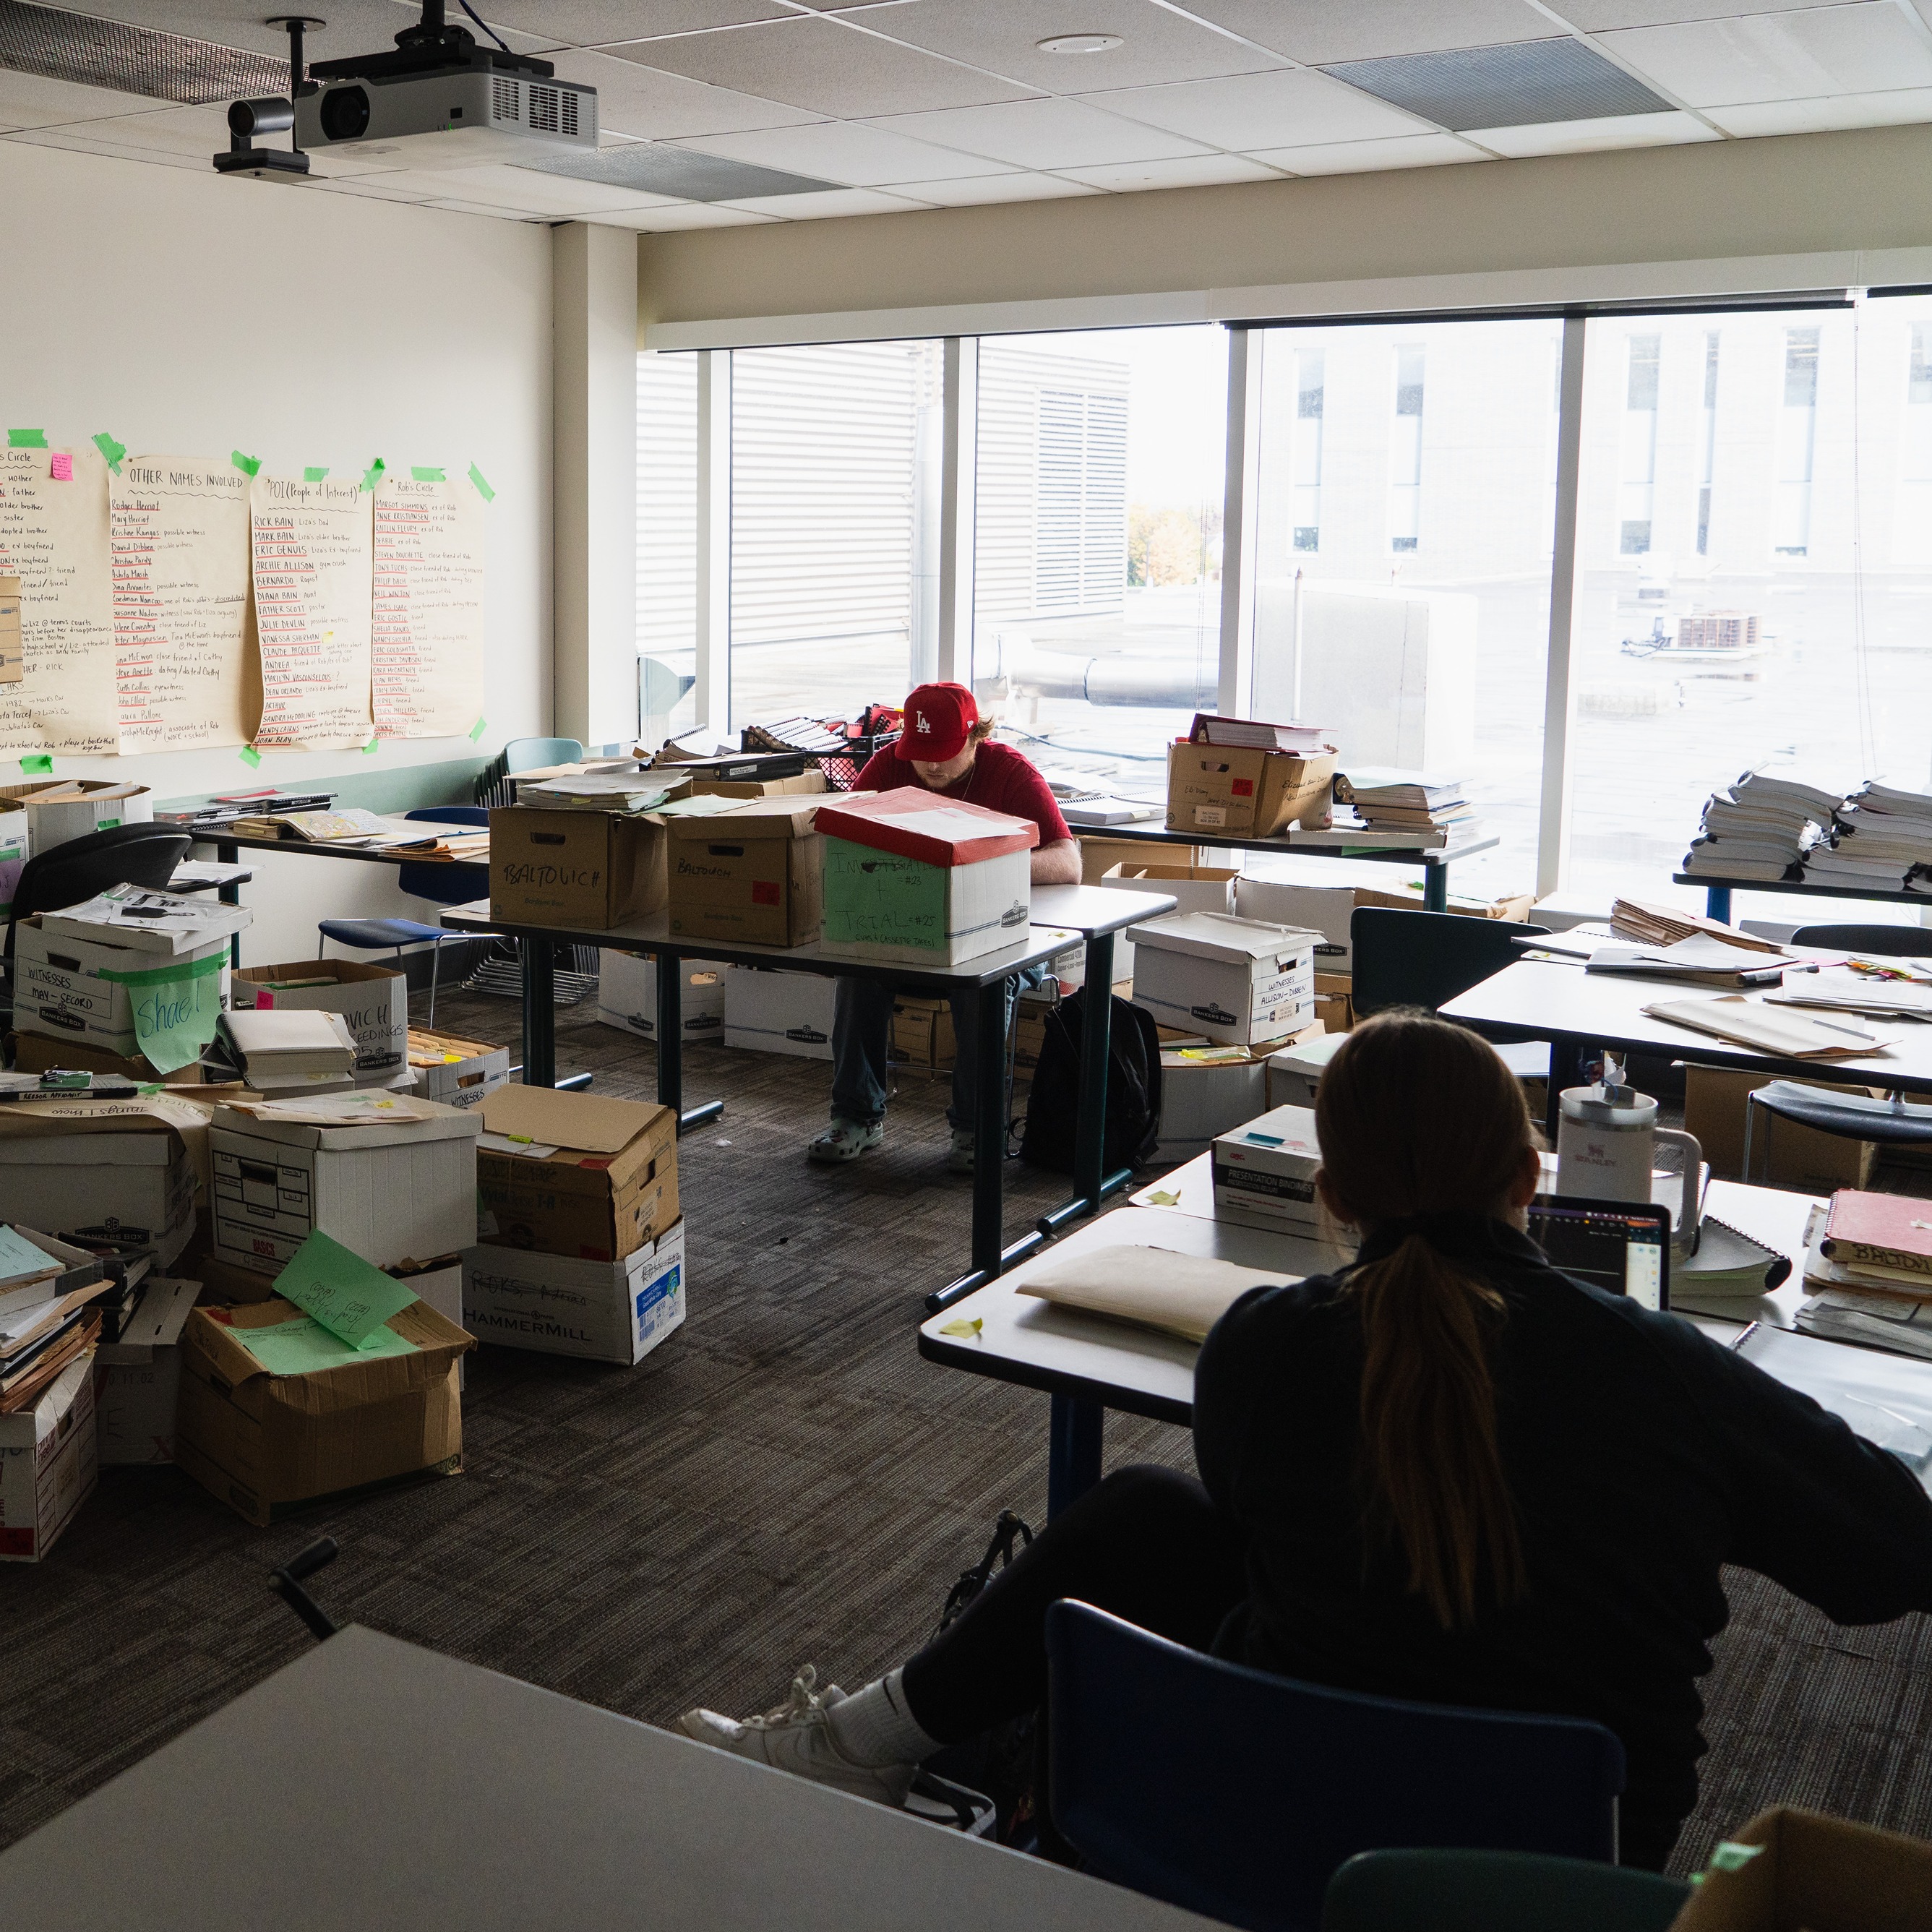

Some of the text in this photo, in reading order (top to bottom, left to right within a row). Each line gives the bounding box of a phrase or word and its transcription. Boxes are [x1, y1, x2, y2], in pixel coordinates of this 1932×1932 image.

[7, 452, 32, 462] Circle
[129, 468, 244, 489] OTHER NAMES INVOLVED
[12, 486, 36, 496] father
[398, 481, 434, 493] Rob's Circle
[376, 499, 428, 510] MARGOT SIMMONS
[254, 515, 275, 528] RICK
[376, 512, 391, 520] ANNE
[255, 532, 275, 541] MARK
[255, 545, 273, 556] ERIC
[255, 561, 281, 571] ARCHIE
[257, 592, 279, 601] DIANA
[258, 605, 305, 615] FATHER SCOTT
[262, 634, 319, 644] VANESSA SHERMAN
[263, 648, 287, 656] CLAUDE
[265, 661, 290, 669] ANDREA
[916, 710, 931, 734] LA
[1002, 914, 1019, 925] BANKERS
[27, 966, 72, 989] WITNESSES
[1268, 976, 1295, 990] WITNESSES
[32, 987, 93, 1010] MAY SECORD
[41, 1010, 82, 1028] BANKERS BOX
[1193, 1009, 1234, 1023] BANKERS BOX
[359, 1058, 387, 1068] BANKERS
[451, 1089, 485, 1107] WITNESSES
[1575, 1153, 1617, 1167] STANLEY
[1227, 1169, 1313, 1193] PRESENTATION BINDINGS
[252, 1238, 275, 1257] BASICS
[462, 1307, 593, 1342] HAMMERMILL
